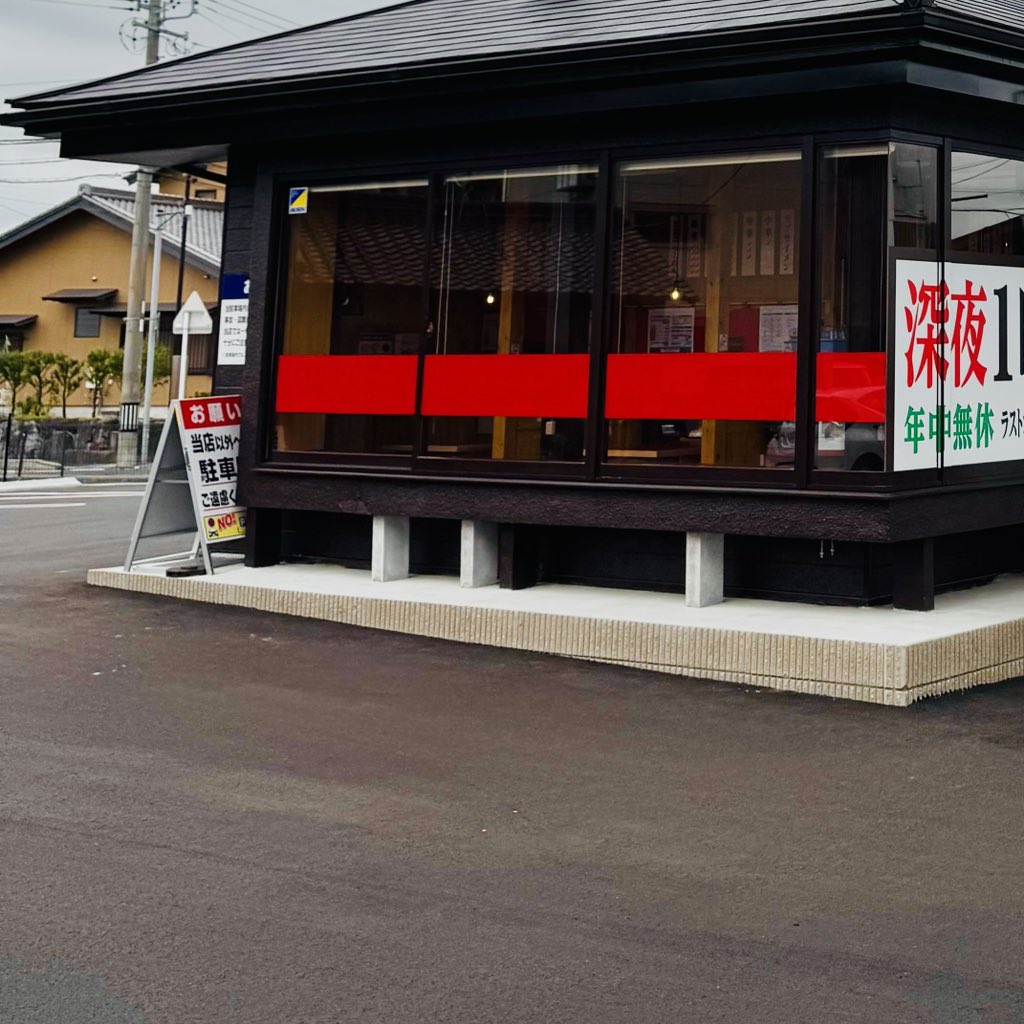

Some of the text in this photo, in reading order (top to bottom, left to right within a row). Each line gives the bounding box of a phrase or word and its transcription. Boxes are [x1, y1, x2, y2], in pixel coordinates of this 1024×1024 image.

[189, 402, 242, 424] お願い
[904, 402, 994, 454] 年中無休
